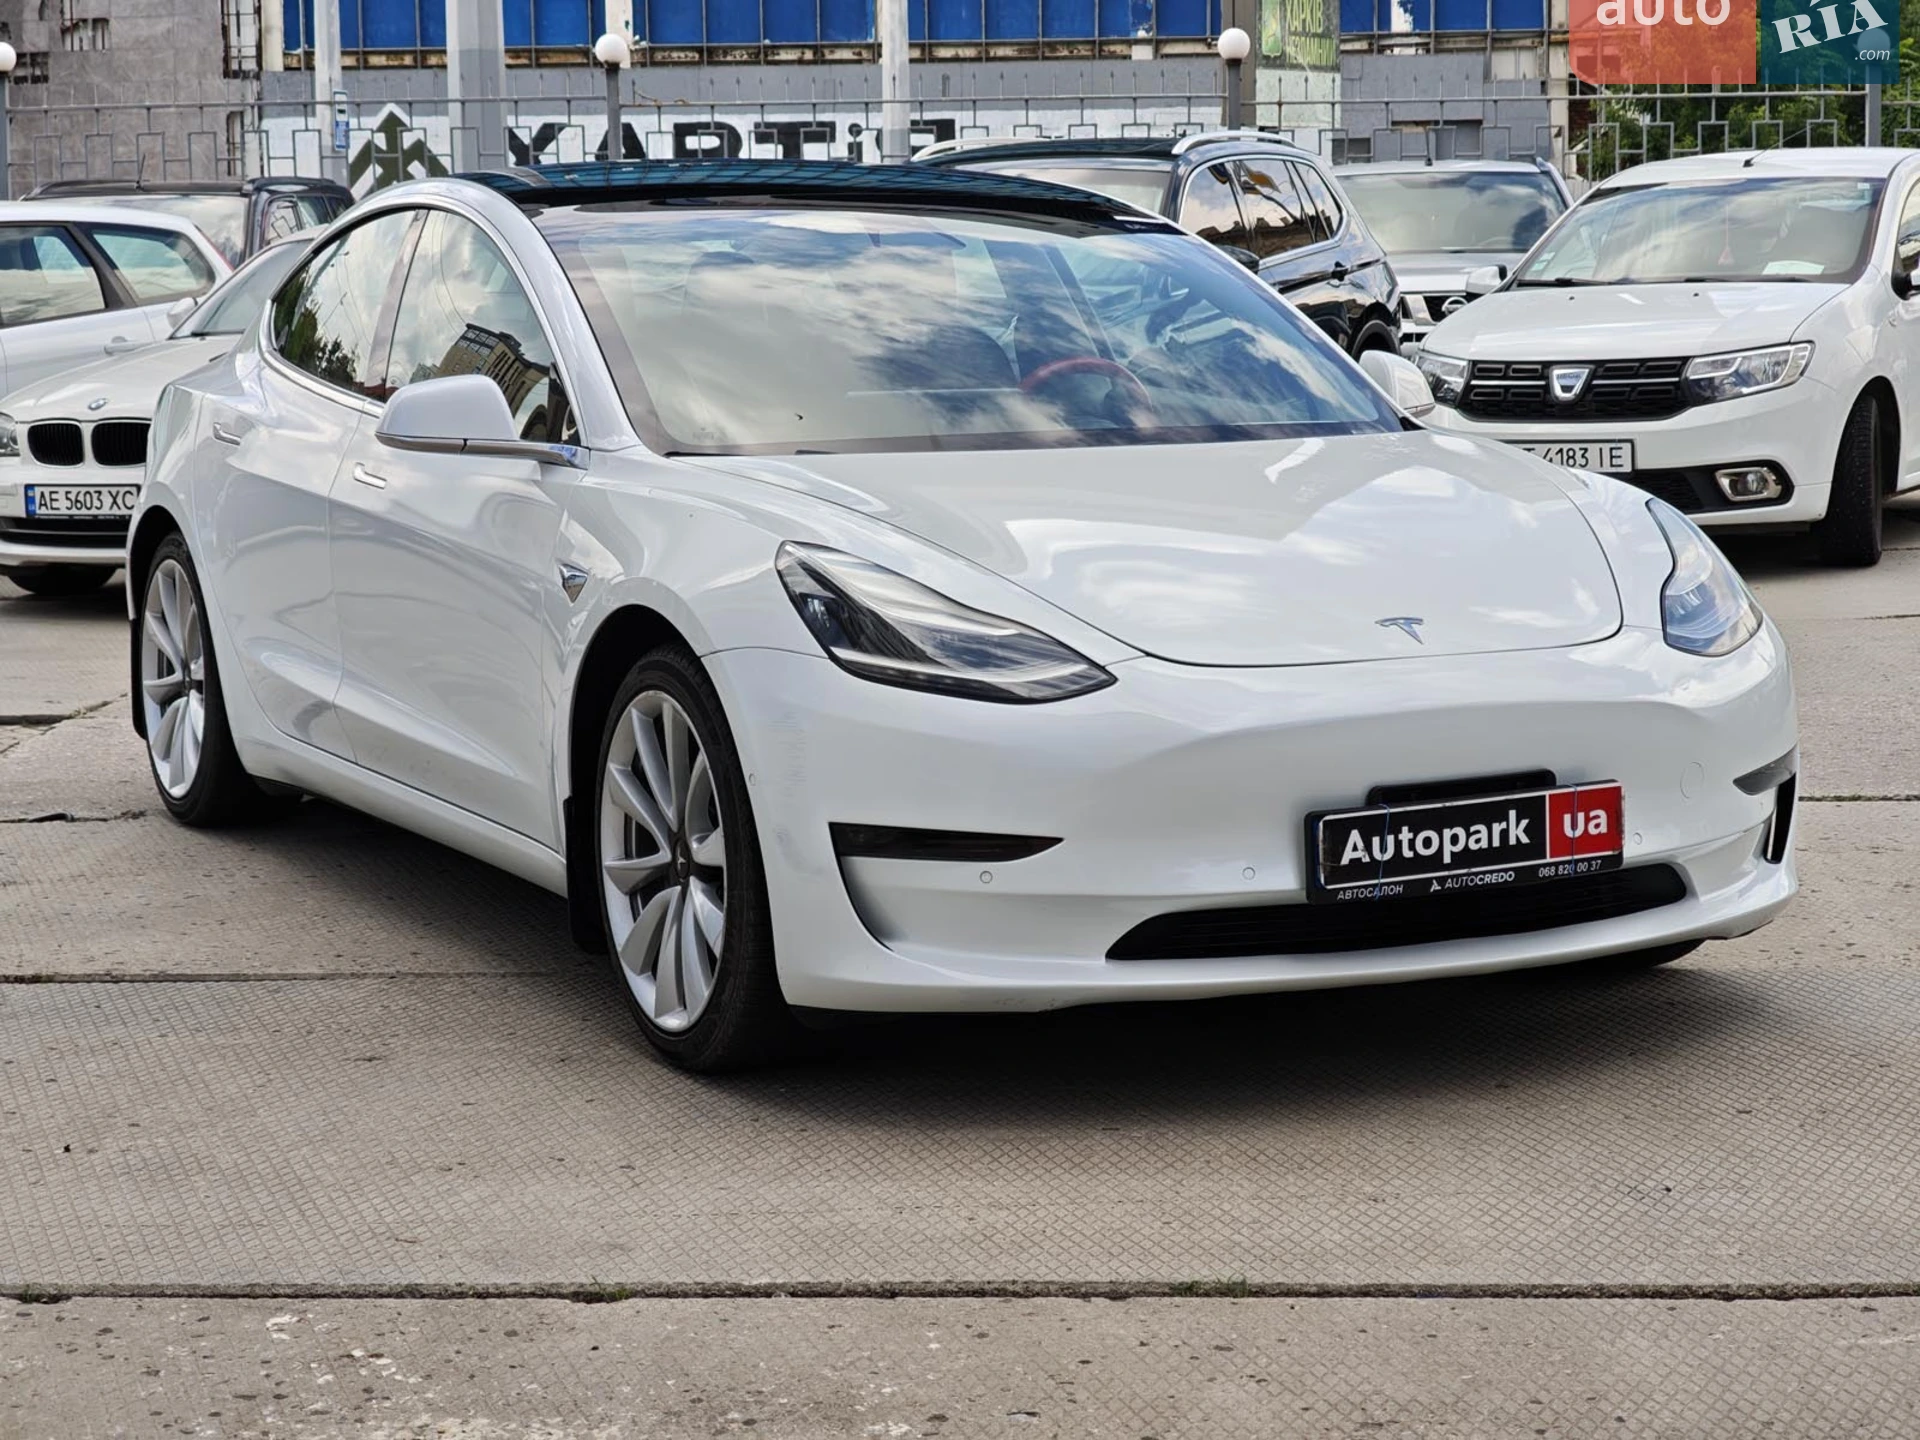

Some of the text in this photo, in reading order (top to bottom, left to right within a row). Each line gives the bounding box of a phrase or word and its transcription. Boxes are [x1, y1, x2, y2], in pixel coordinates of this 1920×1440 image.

[1285, 0, 1324, 33] ХАРКІВ
[1543, 447, 1624, 468] 4183 IE
[38, 490, 60, 511] AE
[65, 490, 103, 511] 5603
[107, 490, 135, 511] XC
[1339, 808, 1608, 865] Autopark ua
[1538, 866, 1556, 877] 068
[1577, 862, 1589, 873] 00
[1590, 859, 1602, 871] 37
[1444, 871, 1515, 889] AUTOCREDO
[1337, 884, 1404, 901] АВТОСАЛОН
